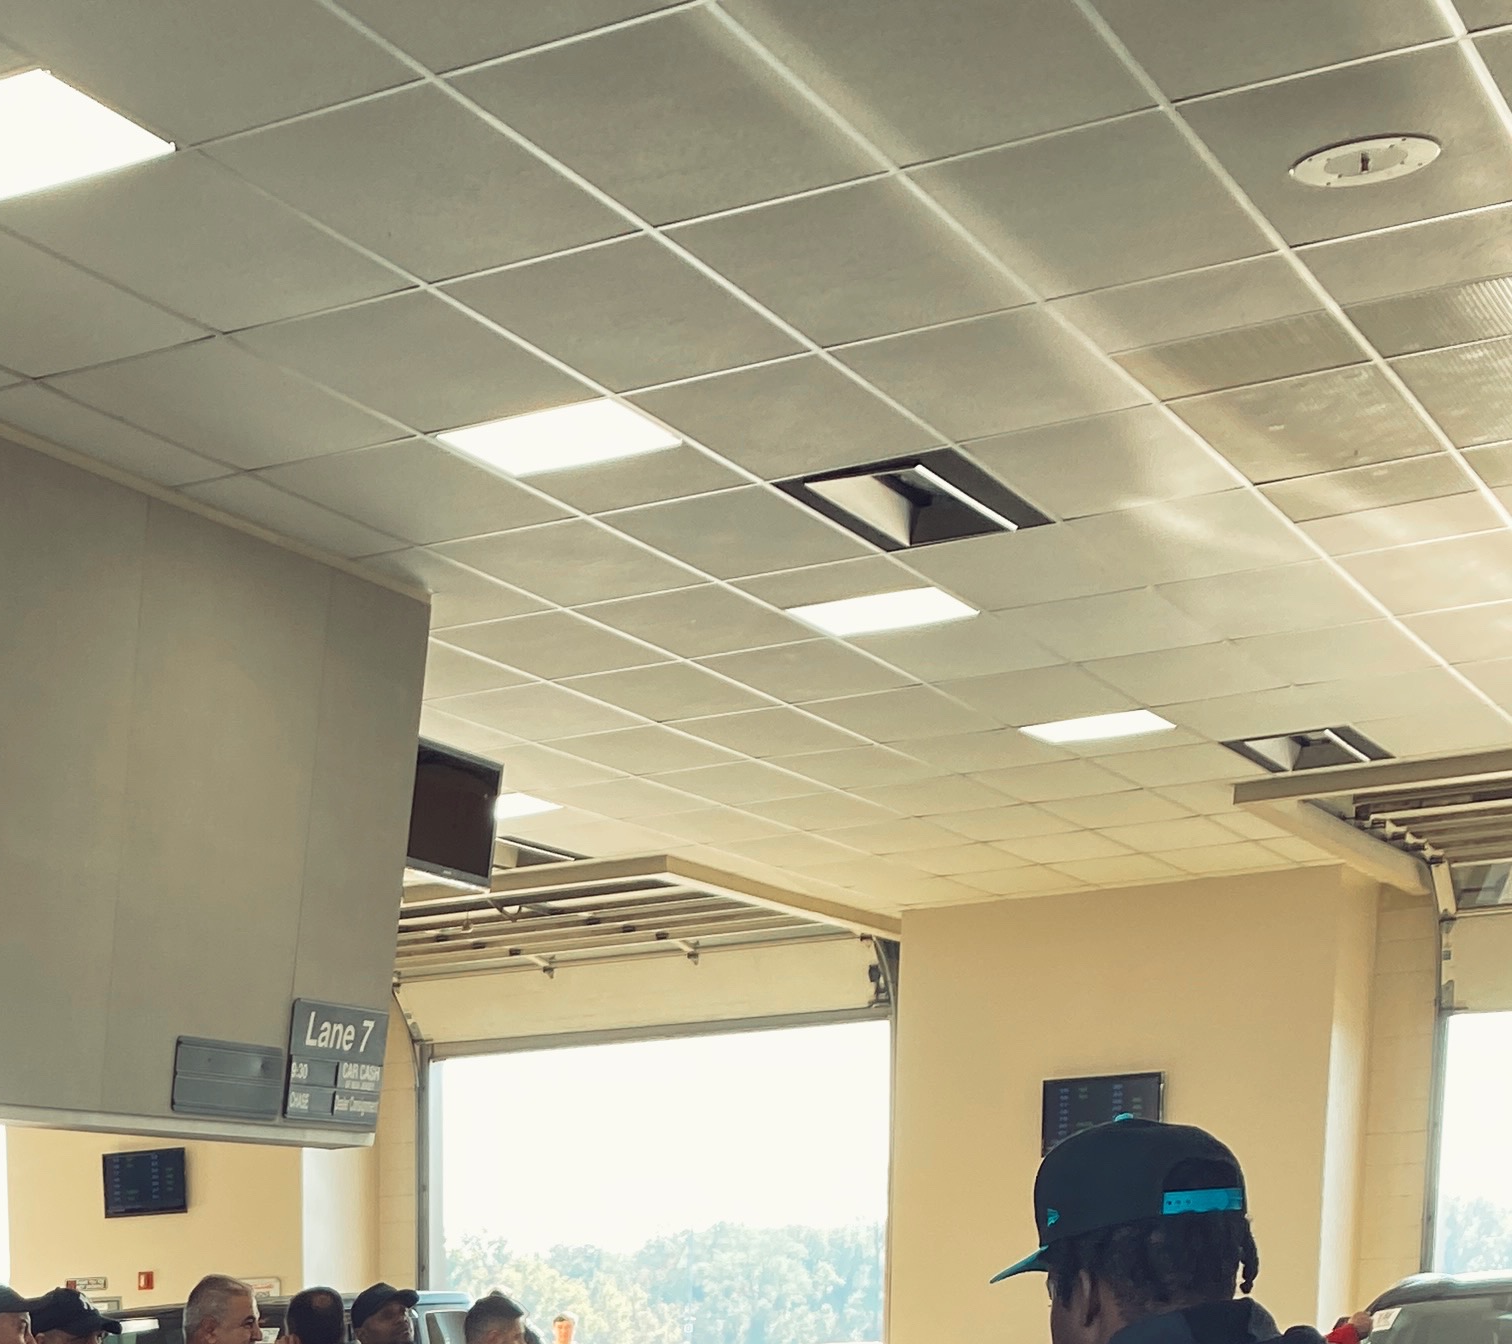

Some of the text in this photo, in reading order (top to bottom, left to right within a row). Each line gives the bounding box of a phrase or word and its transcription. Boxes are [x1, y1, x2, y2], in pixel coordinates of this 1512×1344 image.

[305, 1011, 375, 1052] Lane 7
[342, 1062, 381, 1081] CAR CASH
